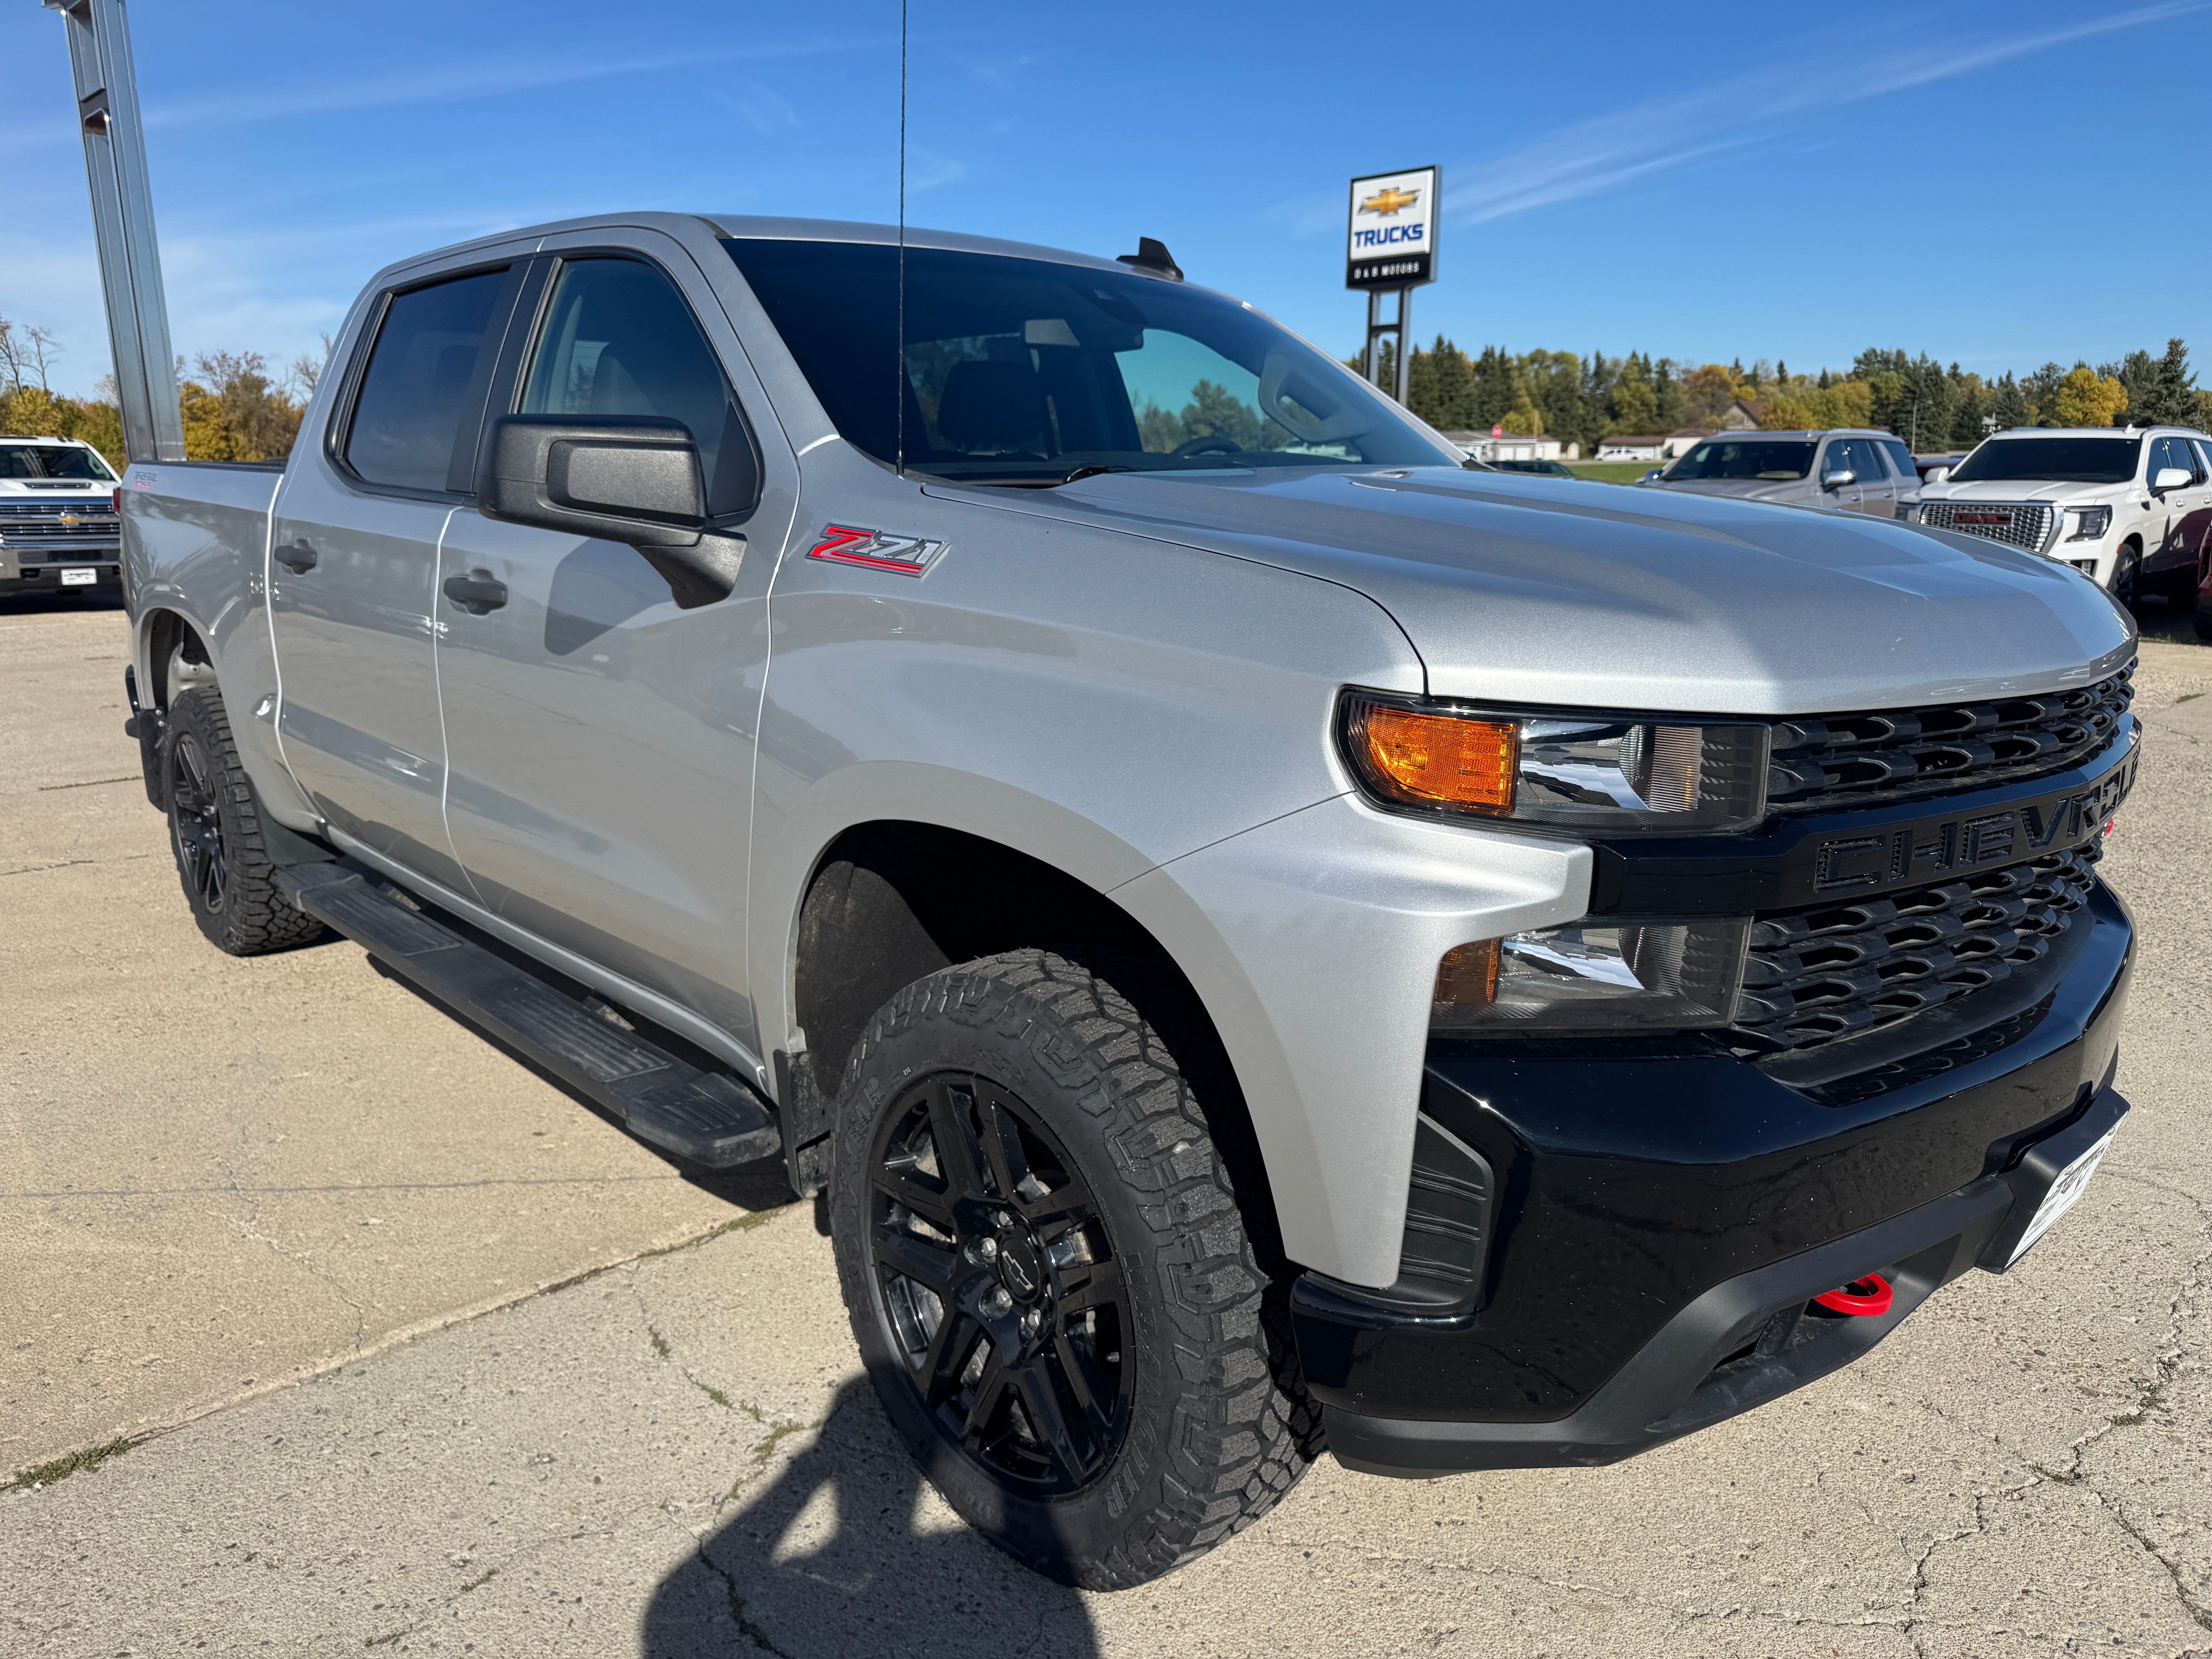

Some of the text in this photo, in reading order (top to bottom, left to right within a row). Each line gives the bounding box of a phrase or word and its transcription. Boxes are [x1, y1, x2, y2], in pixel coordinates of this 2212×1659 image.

[1354, 223, 1423, 247] TRUCKS
[1381, 261, 1420, 276] MOTORS
[805, 523, 950, 578] Z71
[1814, 747, 2140, 893] CHEVROLE
[1106, 1252, 1161, 1517] WRANGLER
